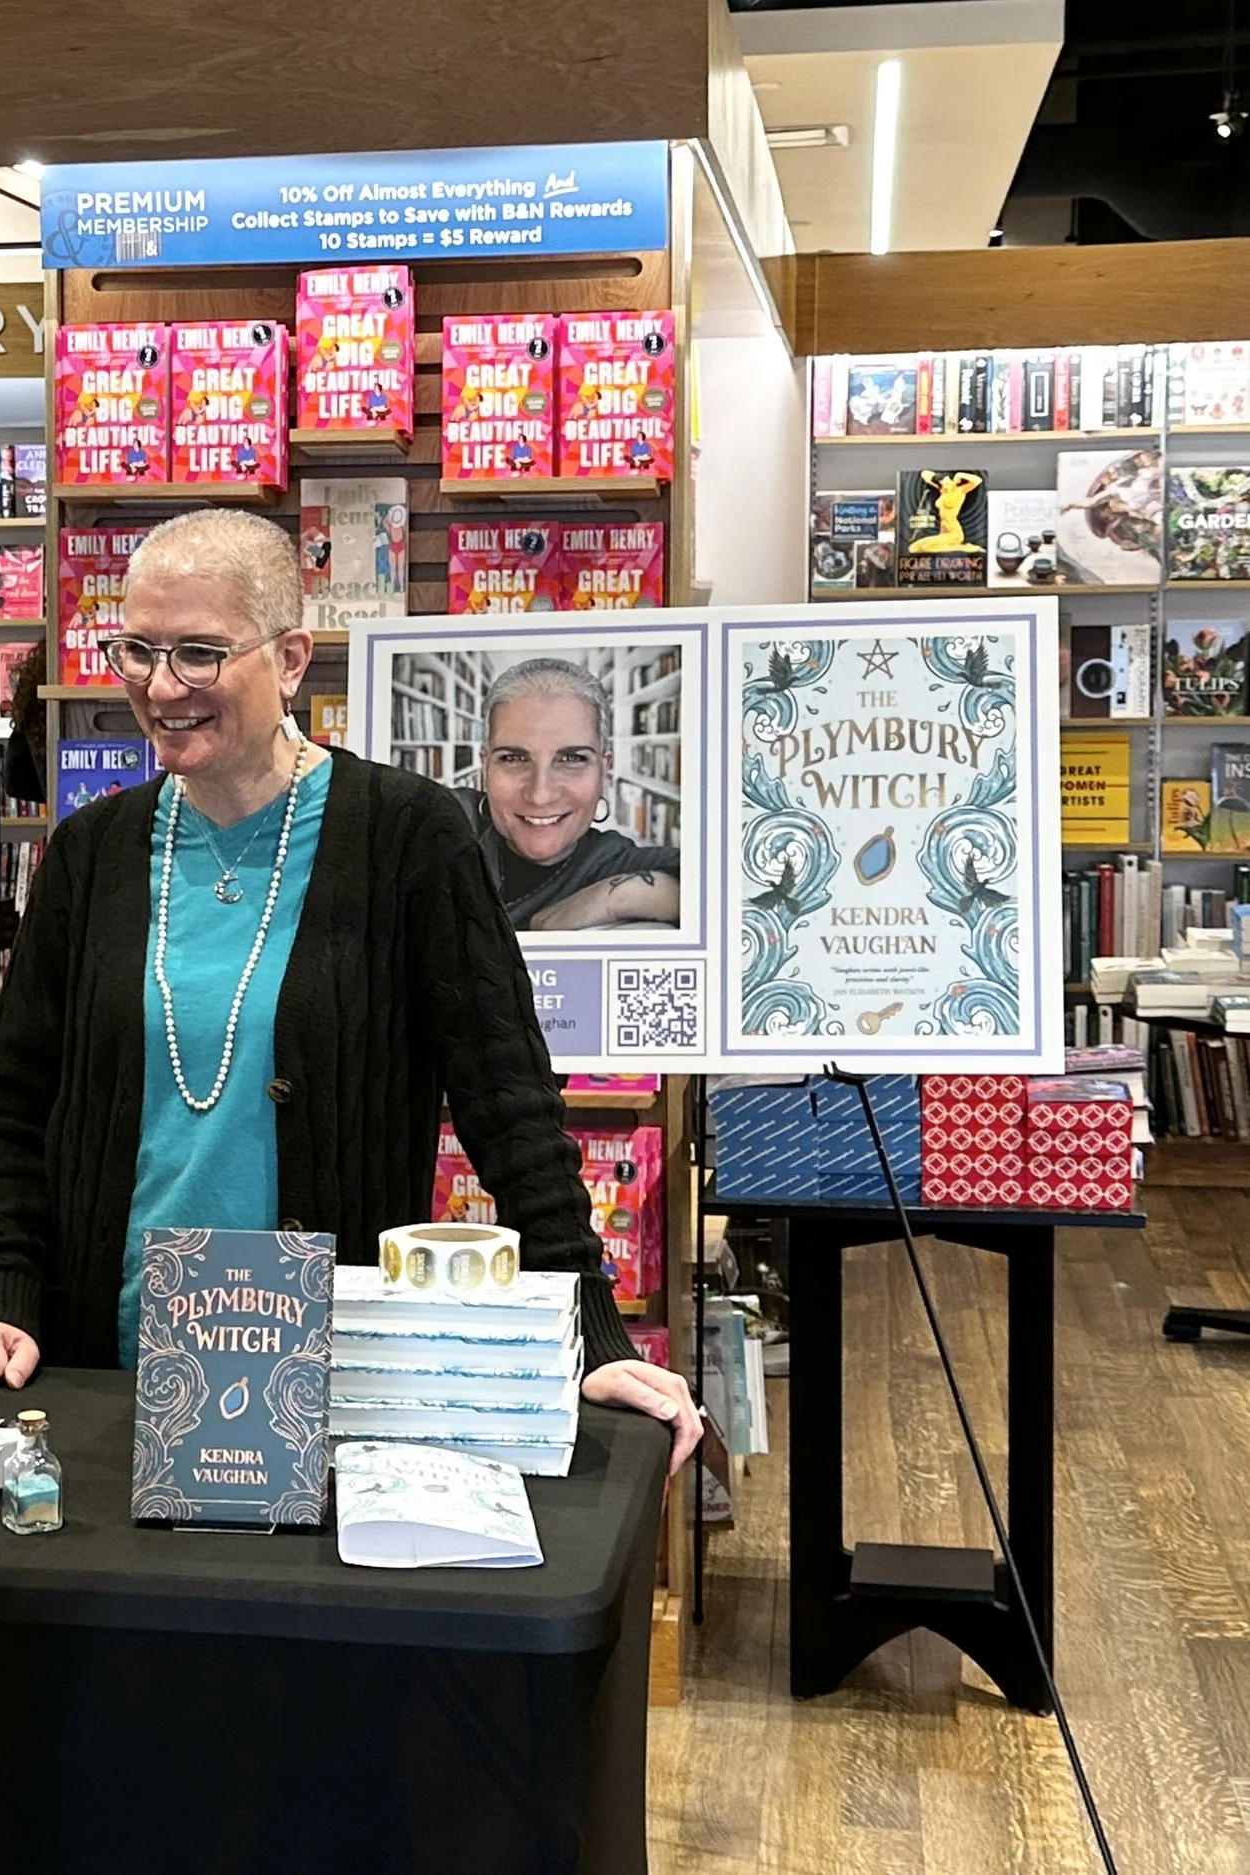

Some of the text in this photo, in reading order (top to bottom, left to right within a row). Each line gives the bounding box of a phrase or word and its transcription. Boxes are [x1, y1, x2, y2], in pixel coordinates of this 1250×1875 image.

[280, 170, 579, 203] 10% Off Almost Everything And
[77, 189, 206, 215] PREMIUM
[77, 215, 209, 236] MEMBERSHIP
[231, 199, 633, 230] Collect Stamps to Save with B&N Rewards
[318, 226, 543, 251] 10 Stamps = $5 Reward
[307, 271, 400, 297] EMILY HENRY
[323, 313, 389, 339] GREAT
[451, 321, 545, 346] EMILY HENRY
[568, 318, 663, 343] EMILY HENRY
[67, 328, 157, 352] EMILY HENRY
[177, 327, 256, 351] EMILY HEN
[335, 340, 376, 367] BIG
[82, 370, 146, 394] GREAT
[192, 368, 257, 392] GREAT
[304, 369, 402, 393] BEAUTIFUL
[466, 363, 533, 388] GREAT
[584, 361, 651, 386] GREAT
[95, 397, 133, 422] BIG
[205, 396, 244, 421] BIG
[318, 393, 363, 419] LIFE
[479, 391, 520, 417] BIG
[597, 389, 638, 415] BIG
[65, 425, 160, 448] BEAUTIFUL
[175, 423, 270, 447] BEAUTIFUL
[447, 419, 547, 443] BEAUTIFUL
[565, 418, 665, 442] BEAUTIFUL
[79, 448, 123, 474] LIFE
[189, 447, 233, 472] LIFE
[462, 444, 507, 469] LIFE
[580, 442, 626, 468] LIFE
[323, 484, 381, 508] Emily
[320, 506, 384, 530] Henry
[67, 535, 107, 556] EMILY
[458, 527, 550, 551] EMILY HEY
[563, 528, 656, 551] EMILY HENRY
[310, 574, 395, 601] Beach
[473, 568, 539, 593] GREAT
[578, 569, 644, 593] GREAT
[487, 596, 526, 615] BIG
[595, 596, 631, 611] BIG
[857, 690, 898, 709] THE
[61, 750, 98, 770] EMILY
[770, 717, 987, 779] PLYMBURY
[801, 769, 947, 810] WITCH
[830, 906, 930, 926] KENDRA
[819, 935, 938, 955] VAUGHAN
[587, 1141, 634, 1161] HENRY
[225, 1268, 253, 1282] THE
[167, 1286, 309, 1330] PLYMBURY
[186, 1320, 282, 1353] WITCH
[200, 1448, 264, 1465] KENDRA
[192, 1469, 269, 1485] VAUGHAN
